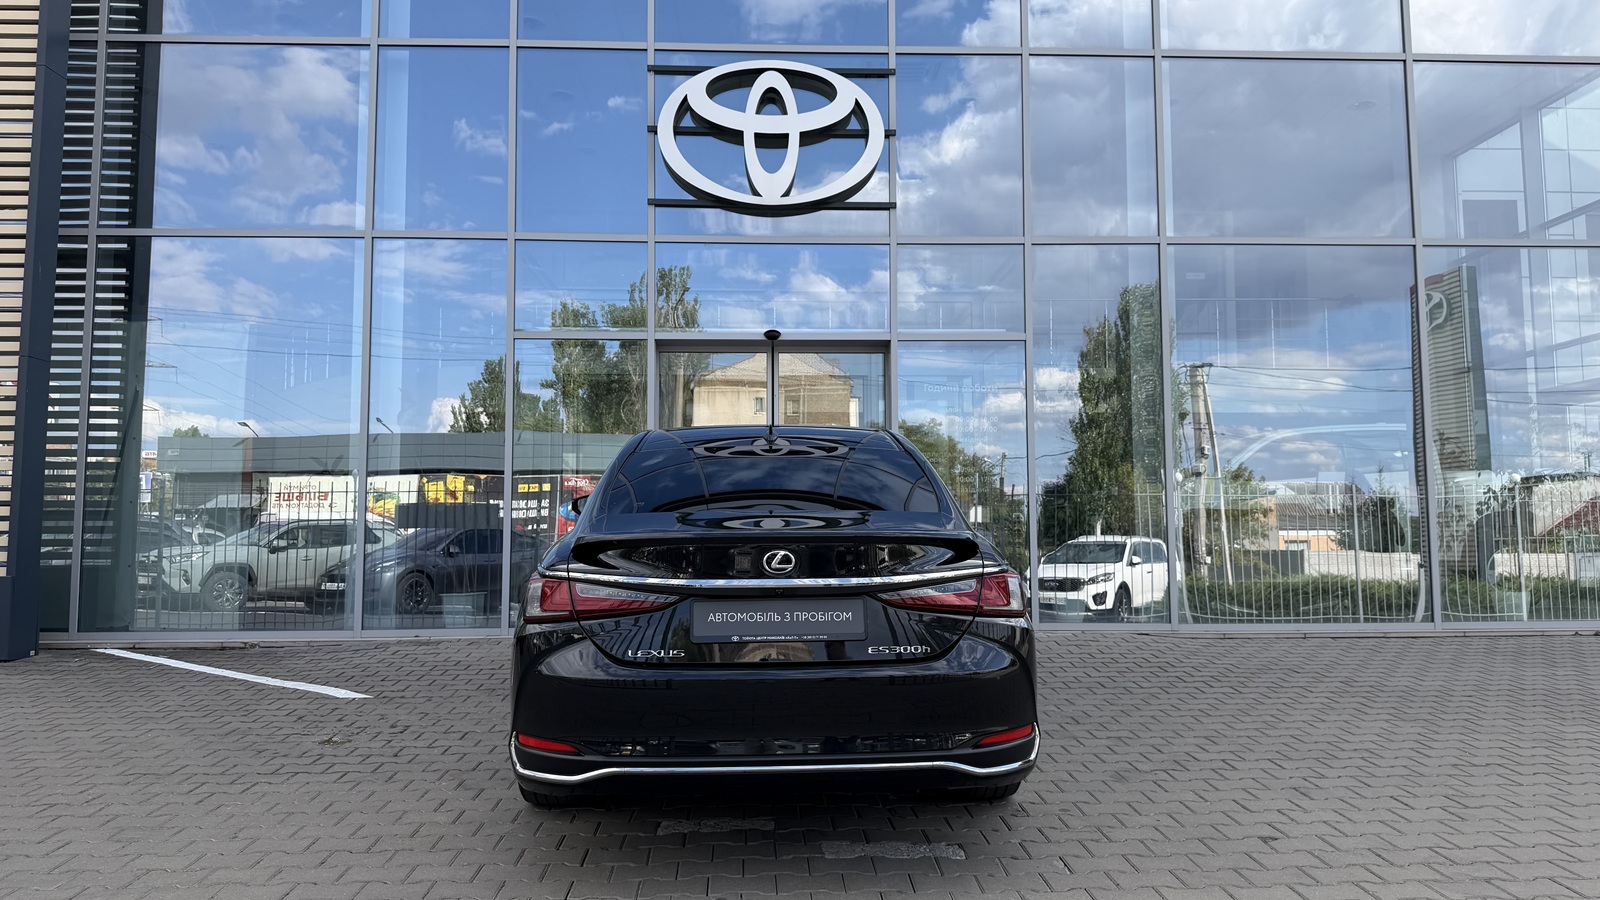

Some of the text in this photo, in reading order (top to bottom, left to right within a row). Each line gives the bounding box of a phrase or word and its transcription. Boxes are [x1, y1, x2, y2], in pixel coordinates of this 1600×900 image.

[924, 383, 998, 392] Години роботи
[708, 611, 853, 622] АВТОМОБІЛЬ З ПРОБІГОМ
[628, 649, 685, 657] LEXUS
[867, 645, 931, 654] ES300h
